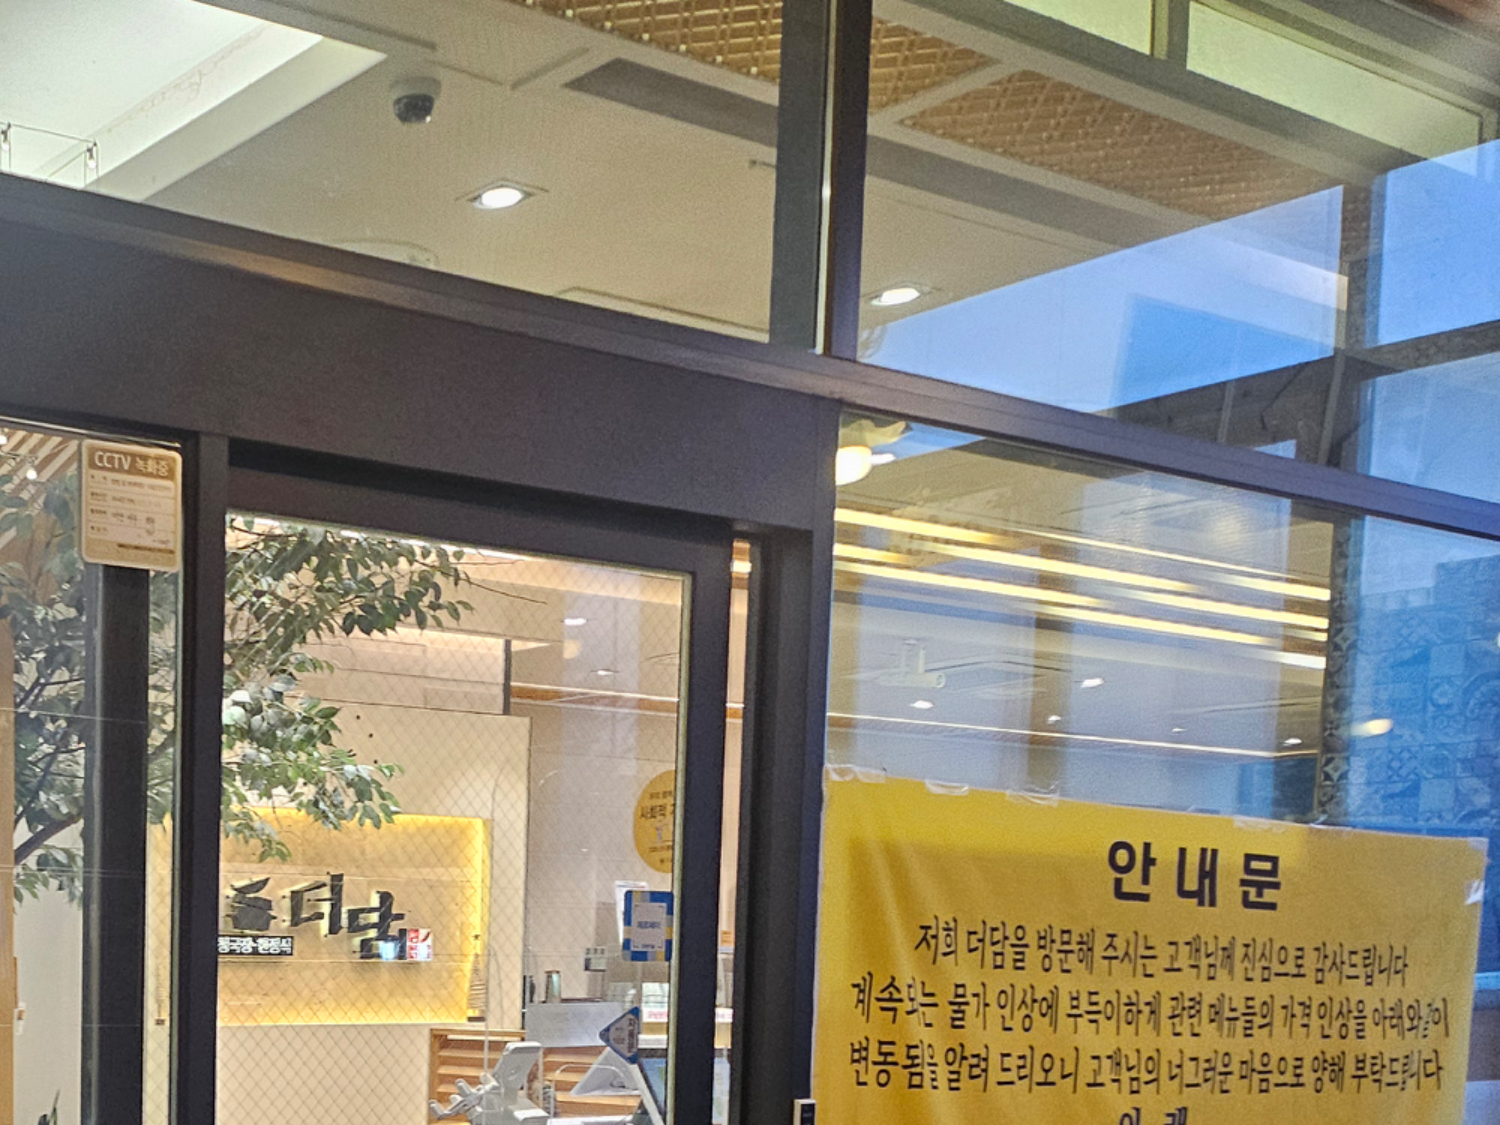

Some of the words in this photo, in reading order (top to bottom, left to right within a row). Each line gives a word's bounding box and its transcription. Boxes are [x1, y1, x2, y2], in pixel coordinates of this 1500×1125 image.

[94, 451, 132, 470] CCTV
[135, 457, 168, 477] 녹화중
[914, 914, 958, 967] 저희
[966, 919, 1030, 971] 더담을
[1036, 924, 1095, 975] 방문해
[1101, 929, 1158, 978] 주시는
[1163, 933, 1236, 981] 고객님께
[1240, 937, 1307, 982] 진심으로
[1313, 941, 1409, 987] 감사드립니다
[850, 971, 939, 1028] 계속되는
[948, 981, 990, 1031] 물가
[996, 982, 1060, 1034] 인상에
[1065, 988, 1161, 1037] 부득이하게
[1167, 992, 1202, 1037] 관련
[1208, 993, 1275, 1038] 메뉴들의
[1280, 994, 1313, 1039] 가격
[1317, 996, 1367, 1040] 인상을
[1372, 997, 1422, 1040] 아래와
[944, 1042, 989, 1093] 알려
[996, 1044, 1080, 1094] 드리오니
[1085, 1046, 1161, 1095] 고객님의
[1167, 1048, 1234, 1095] 너그러운
[1239, 1049, 1306, 1095] 마음으로
[1311, 1050, 1346, 1094] 양해
